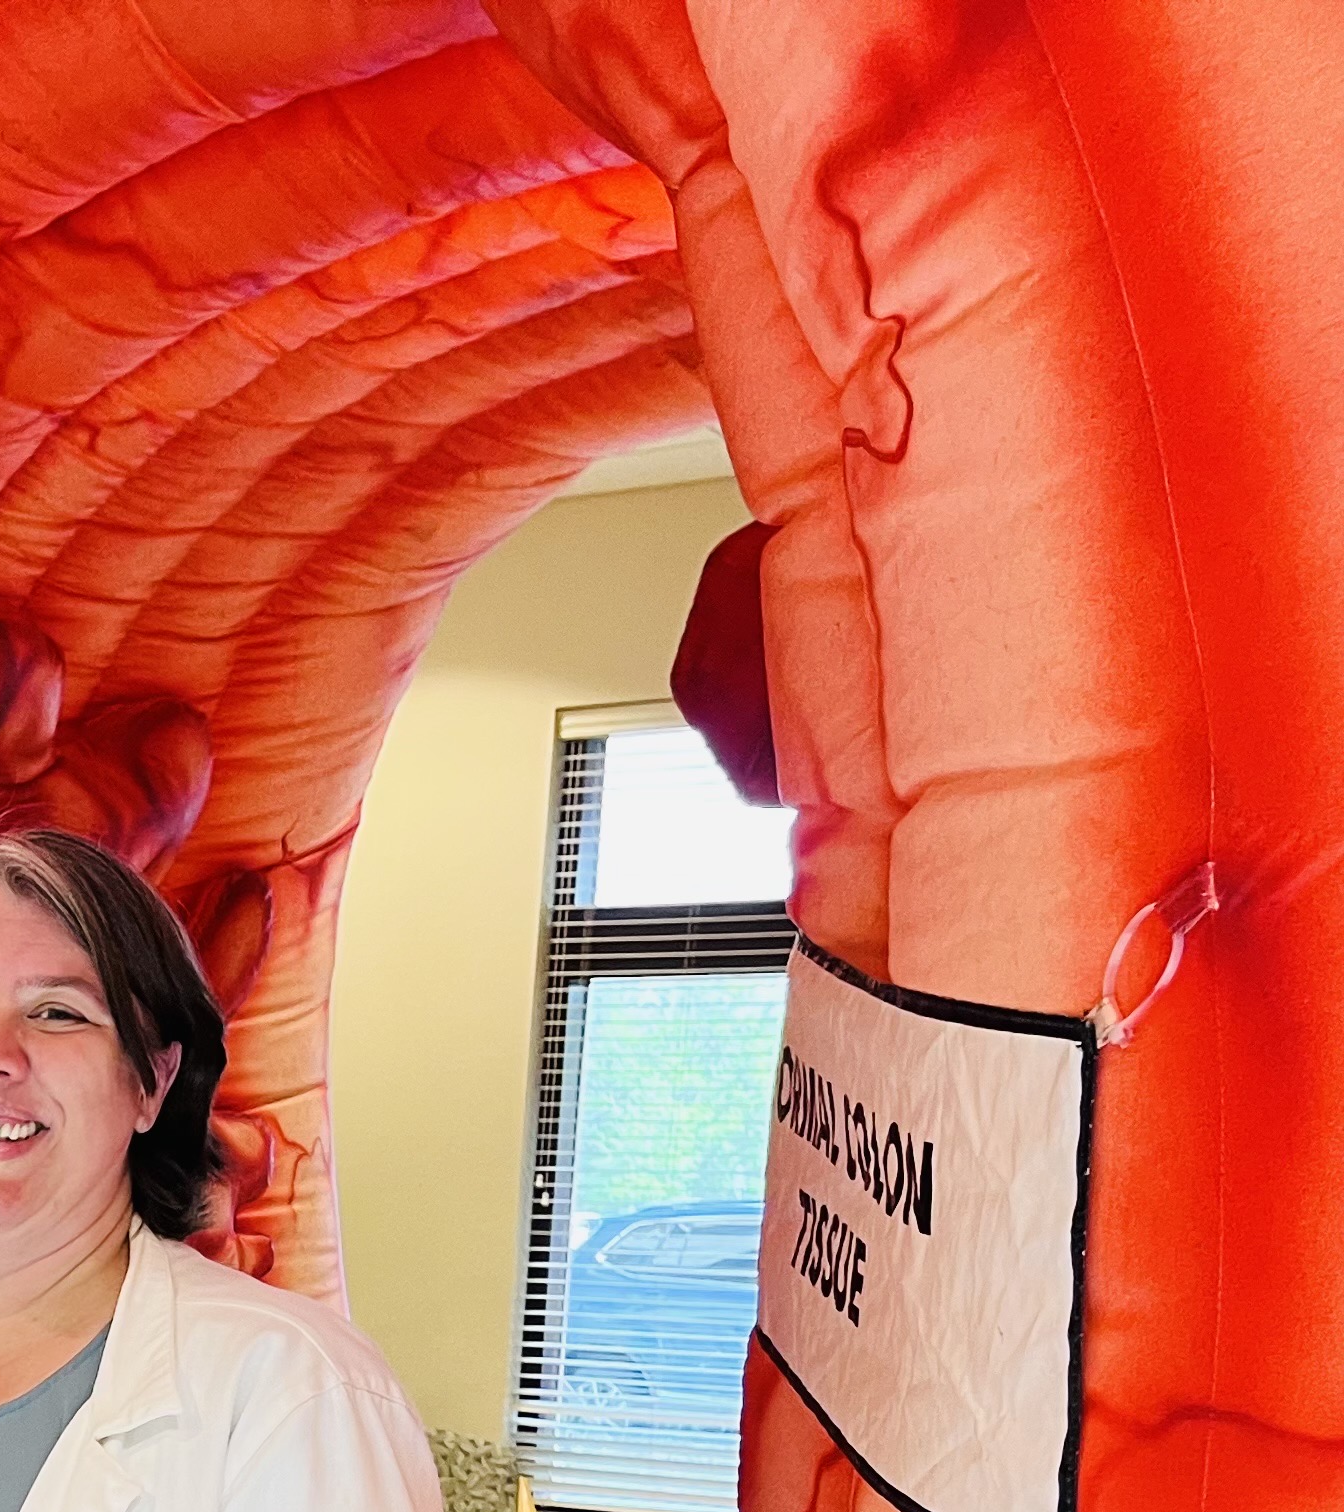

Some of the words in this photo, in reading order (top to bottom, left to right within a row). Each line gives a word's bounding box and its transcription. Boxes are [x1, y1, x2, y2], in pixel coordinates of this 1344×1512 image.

[777, 1046, 839, 1166] ORMAL
[844, 1094, 933, 1235] COLON
[791, 1188, 866, 1328] TISSUE
